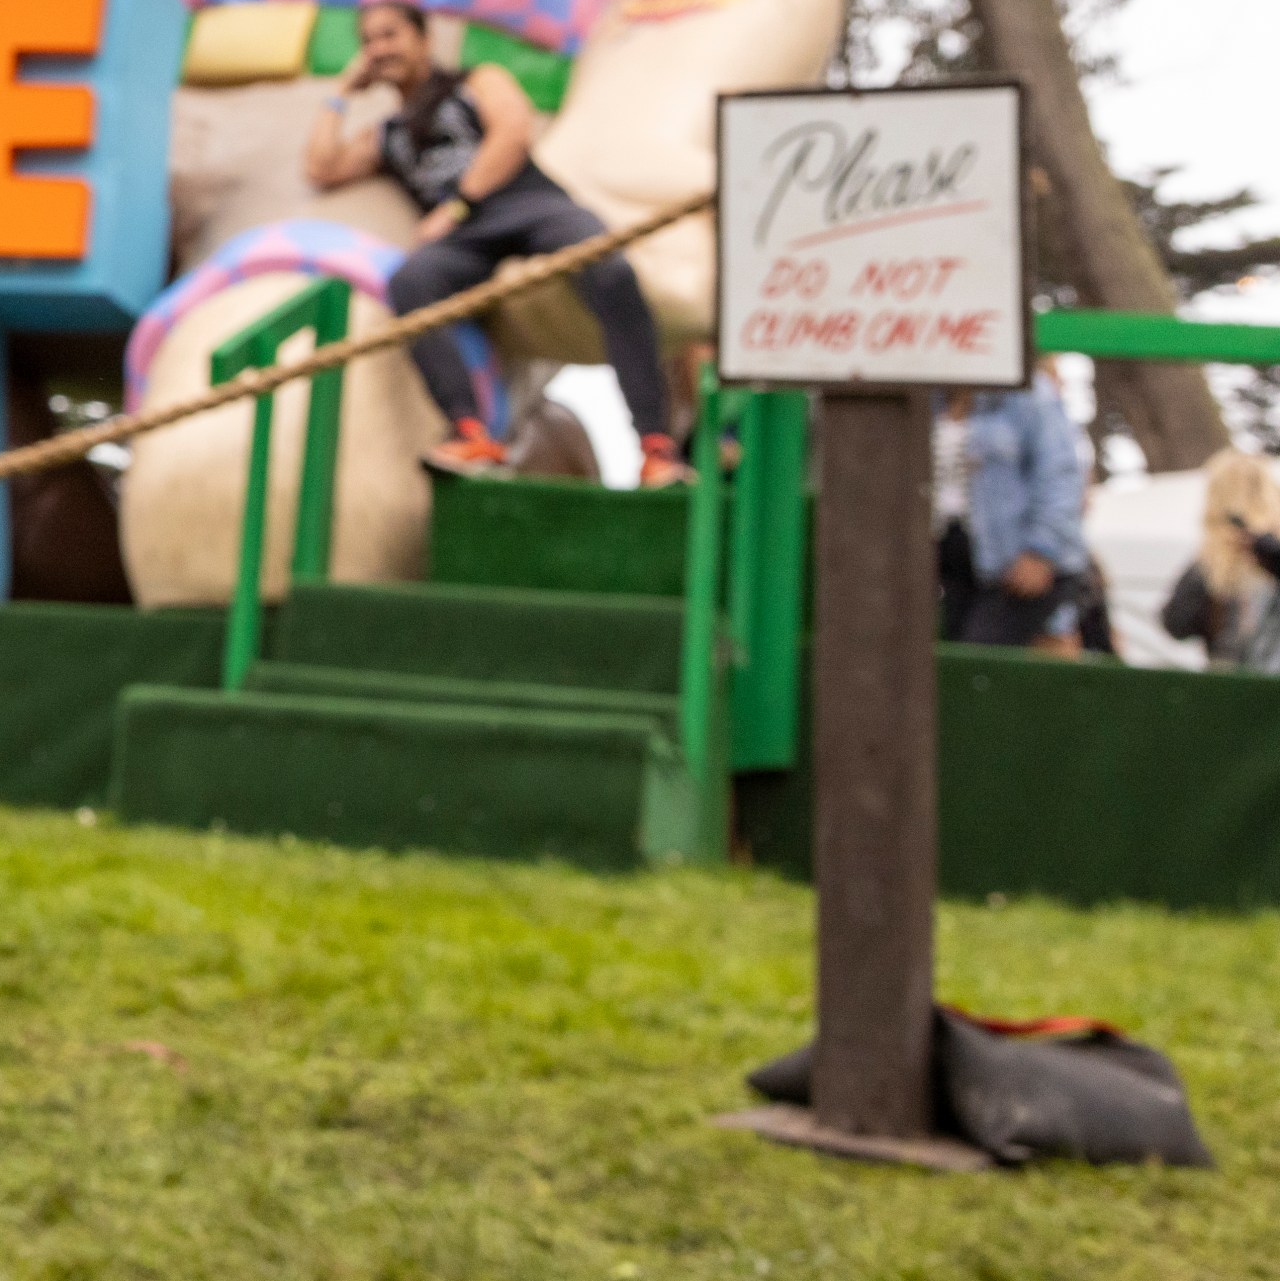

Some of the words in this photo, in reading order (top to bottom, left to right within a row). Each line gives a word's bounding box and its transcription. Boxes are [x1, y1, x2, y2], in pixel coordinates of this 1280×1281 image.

[753, 120, 977, 249] Please
[759, 256, 831, 300] DO
[849, 256, 968, 302] NOT
